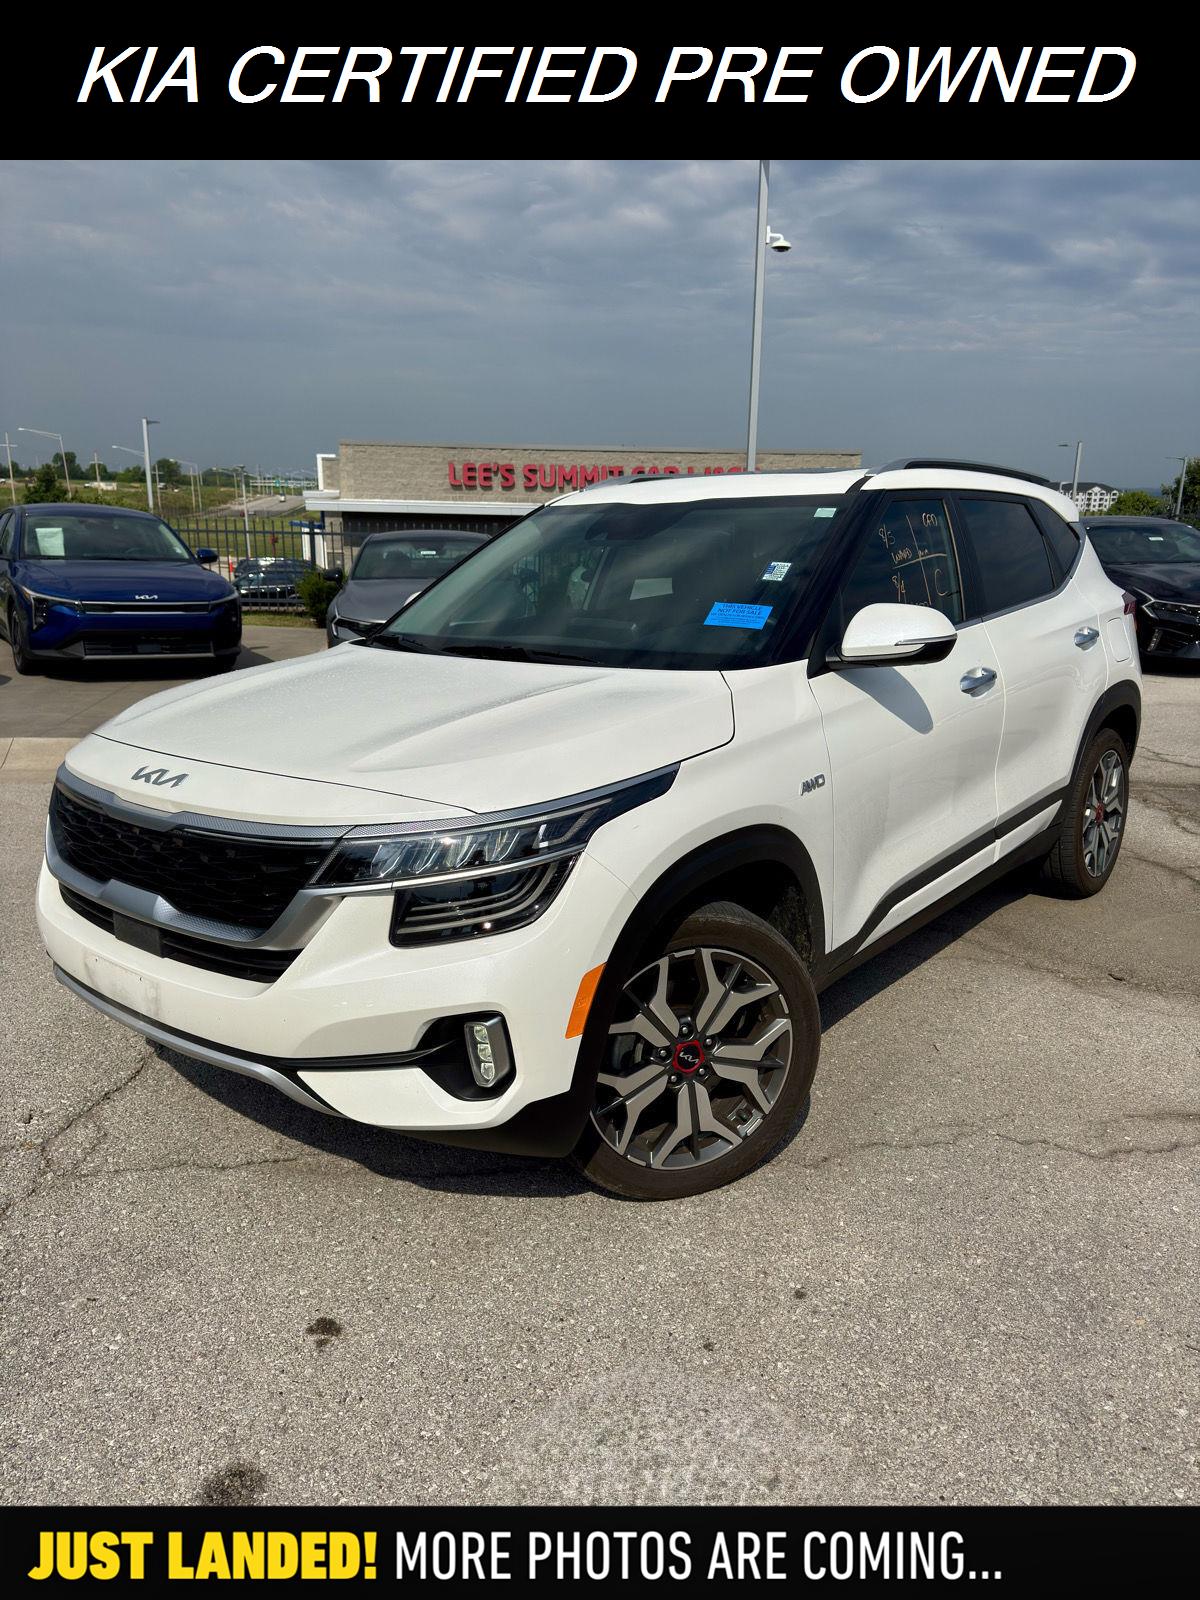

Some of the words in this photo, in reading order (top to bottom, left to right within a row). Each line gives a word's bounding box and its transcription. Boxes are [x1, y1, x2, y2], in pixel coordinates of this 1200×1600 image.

[448, 462, 516, 488] LEE'S
[130, 765, 189, 788] KIA
[800, 774, 826, 796] AWD
